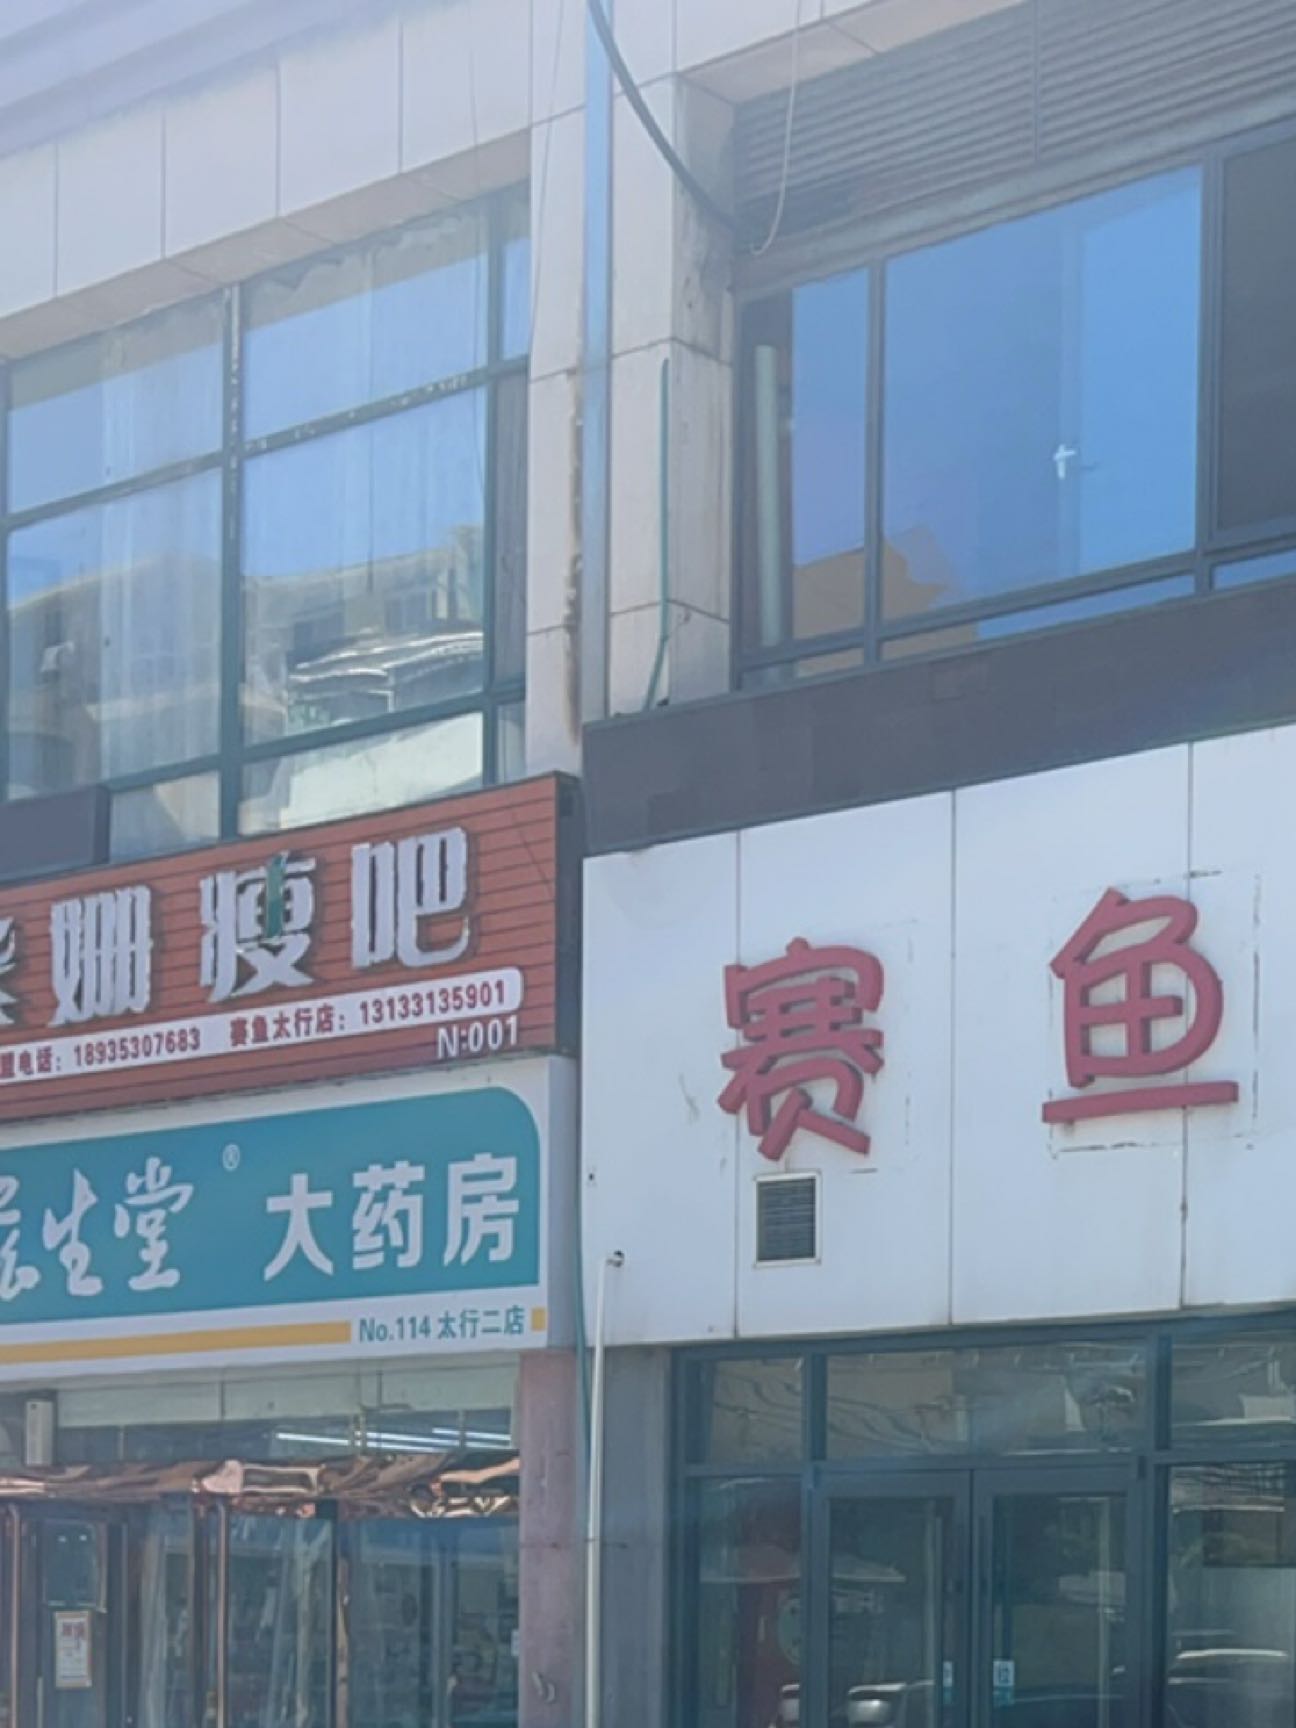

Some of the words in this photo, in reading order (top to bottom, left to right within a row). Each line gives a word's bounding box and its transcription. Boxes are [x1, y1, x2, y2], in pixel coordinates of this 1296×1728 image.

[0, 826, 471, 1028] 姗瘦吧
[74, 1027, 201, 1067] 18935307683
[359, 979, 505, 1025] 13133135901
[263, 1153, 520, 1282] 大药房
[359, 1315, 432, 1343] No.114
[437, 1304, 526, 1340] 太行二店
